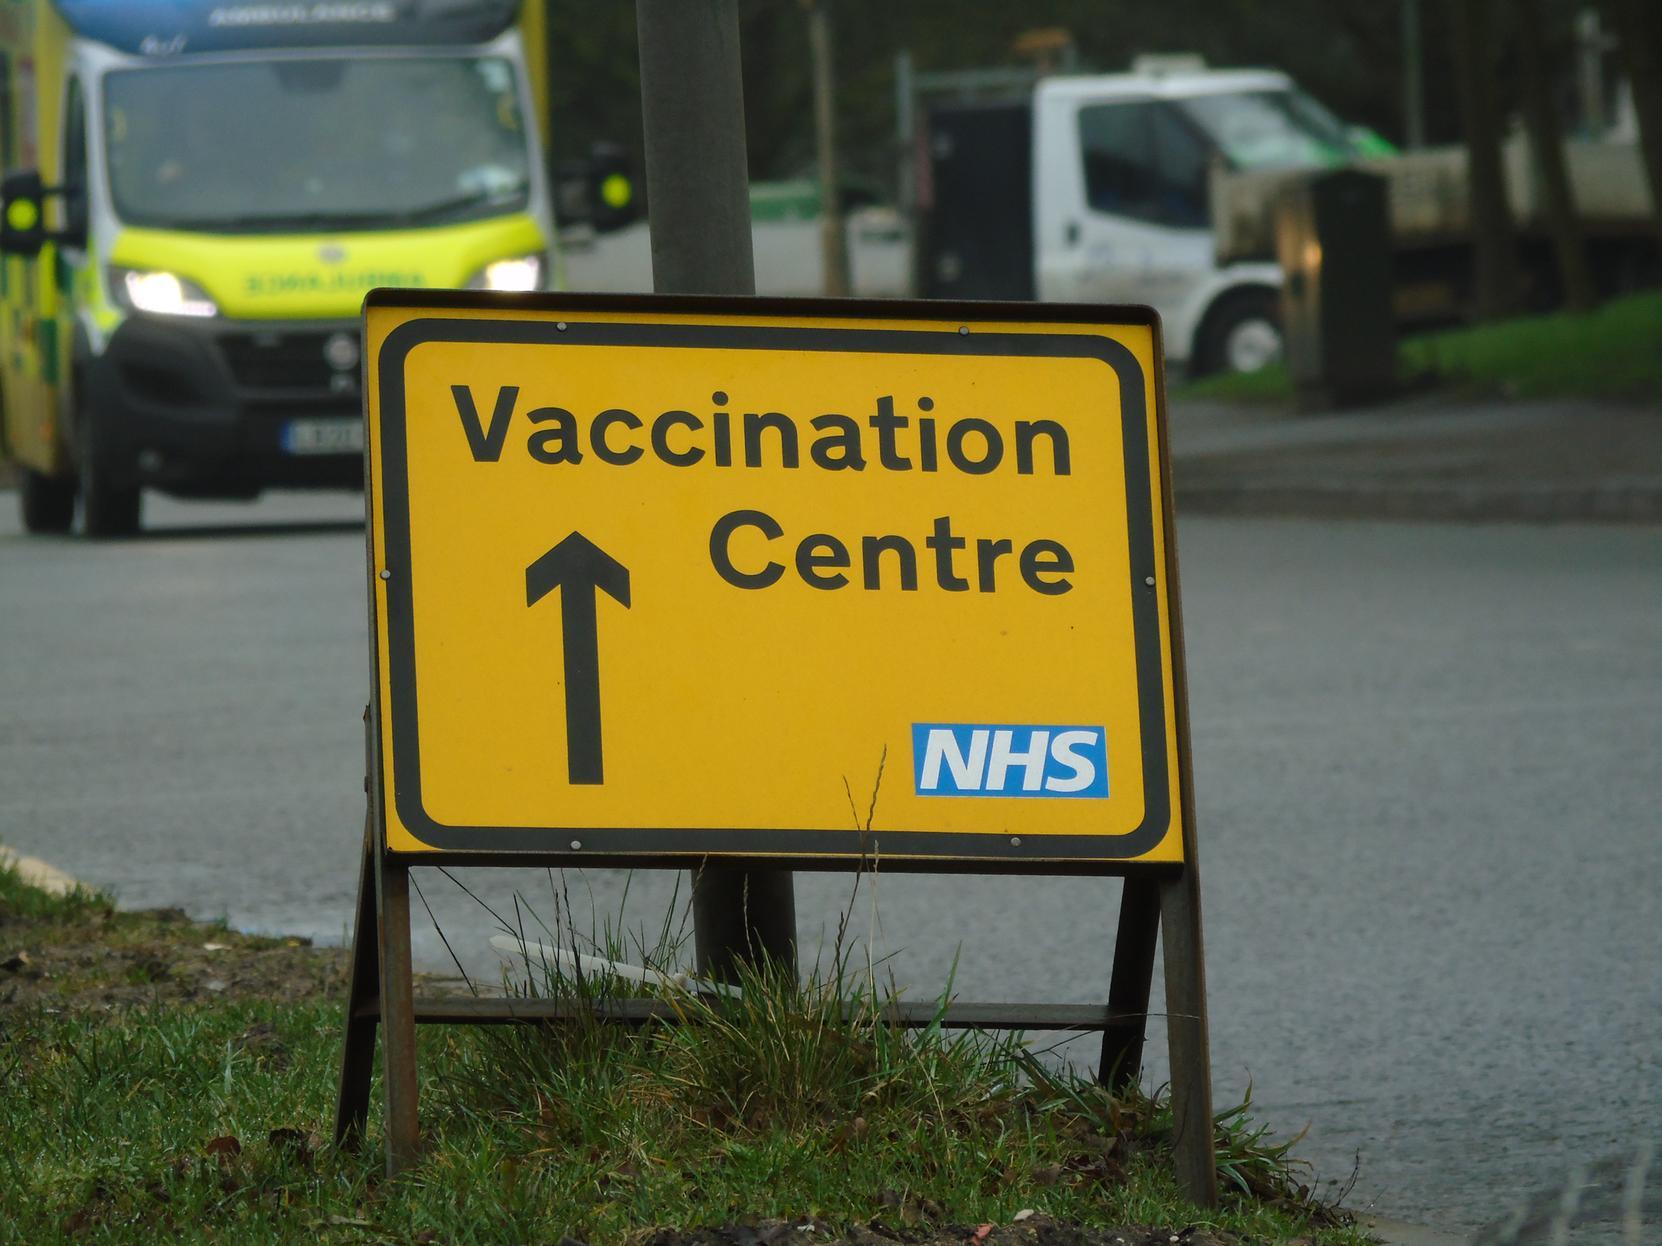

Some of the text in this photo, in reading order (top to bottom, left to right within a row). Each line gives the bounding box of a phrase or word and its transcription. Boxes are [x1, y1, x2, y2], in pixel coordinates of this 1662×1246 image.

[451, 385, 1071, 475] Vaccination
[710, 510, 1074, 595] Centre
[920, 729, 1098, 793] NHS
